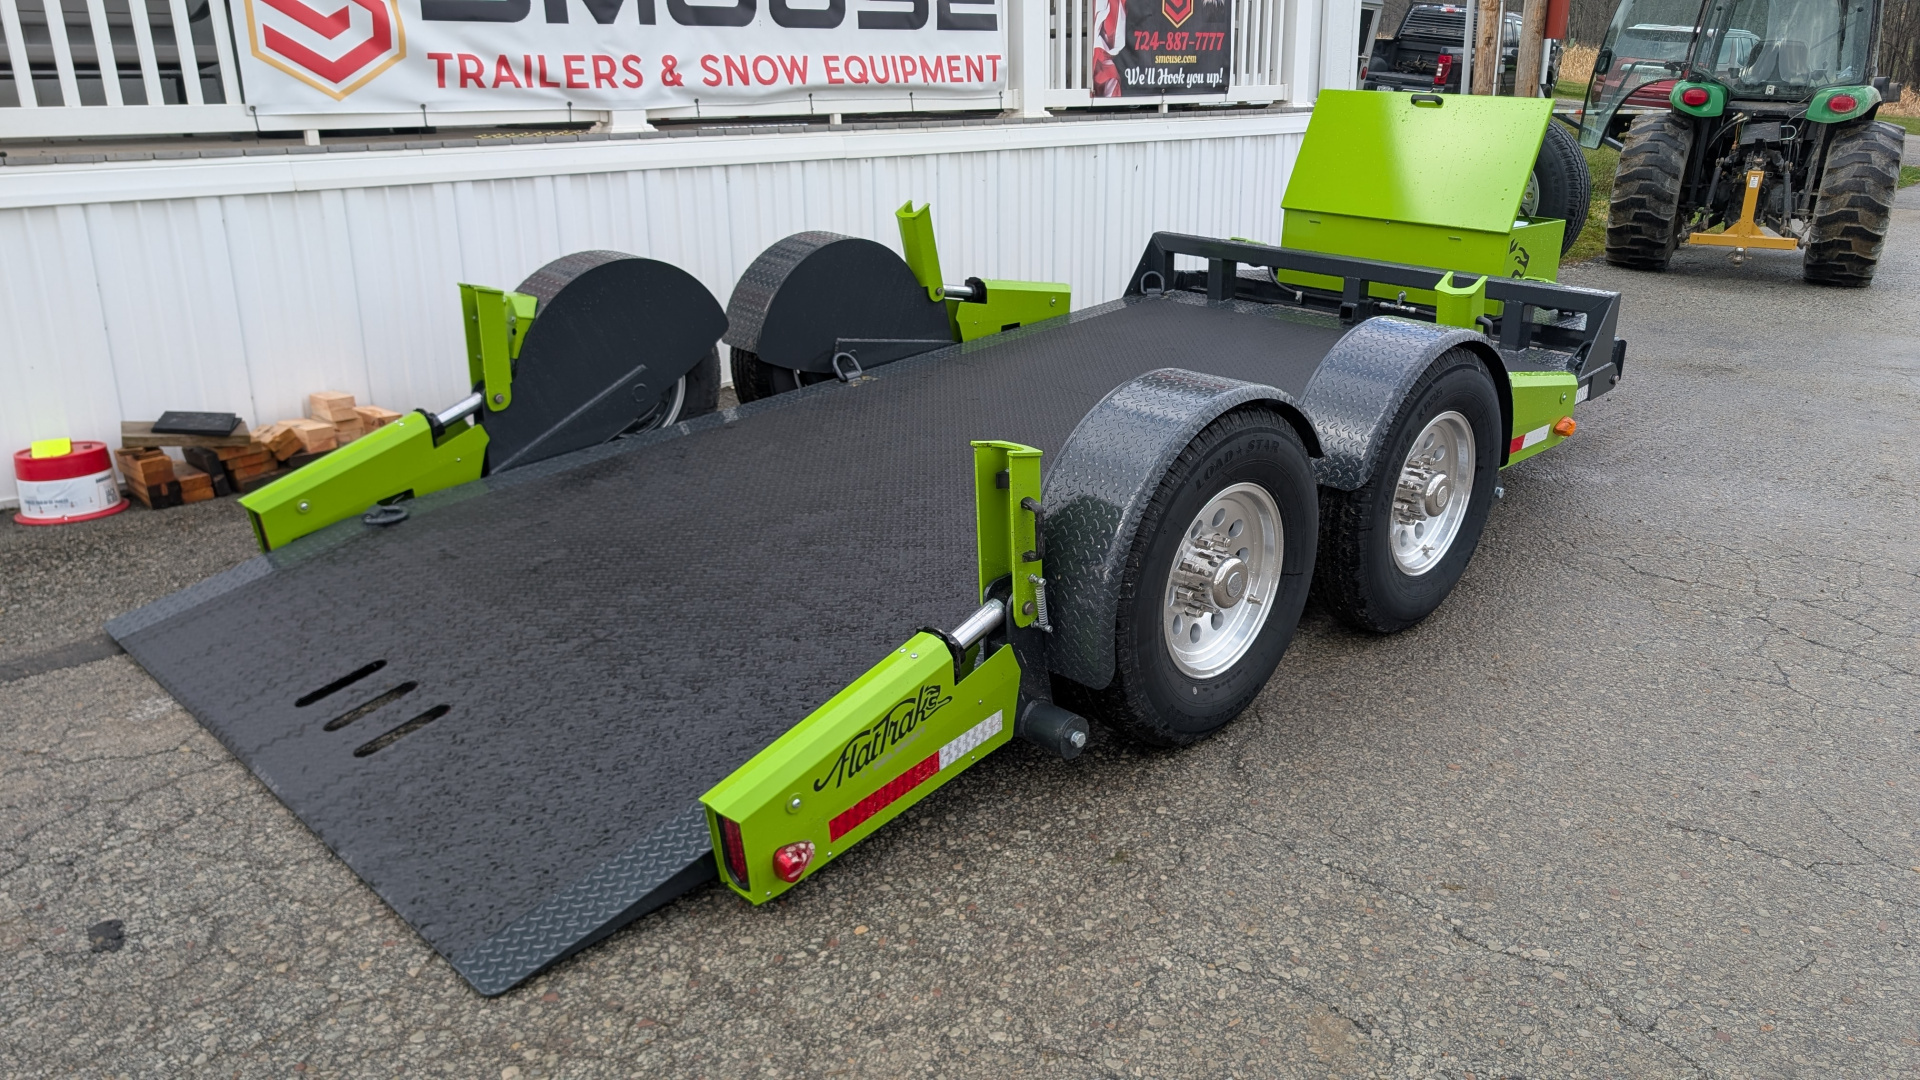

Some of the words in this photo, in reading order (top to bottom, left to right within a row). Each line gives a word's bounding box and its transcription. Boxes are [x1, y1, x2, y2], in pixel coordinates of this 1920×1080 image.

[1134, 31, 1225, 51] 724-887-7777
[1154, 54, 1197, 64] smouse.com
[427, 53, 644, 89] TRAILERS
[661, 54, 685, 87] &
[702, 54, 808, 88] SNOW
[823, 55, 1002, 84] EQUIPMENT
[1124, 66, 1156, 85] We'll
[1157, 68, 1185, 85] Hook
[1186, 72, 1205, 88] you
[1206, 67, 1224, 87] up!
[1195, 449, 1234, 492] LOAD
[1247, 439, 1280, 454] STAR
